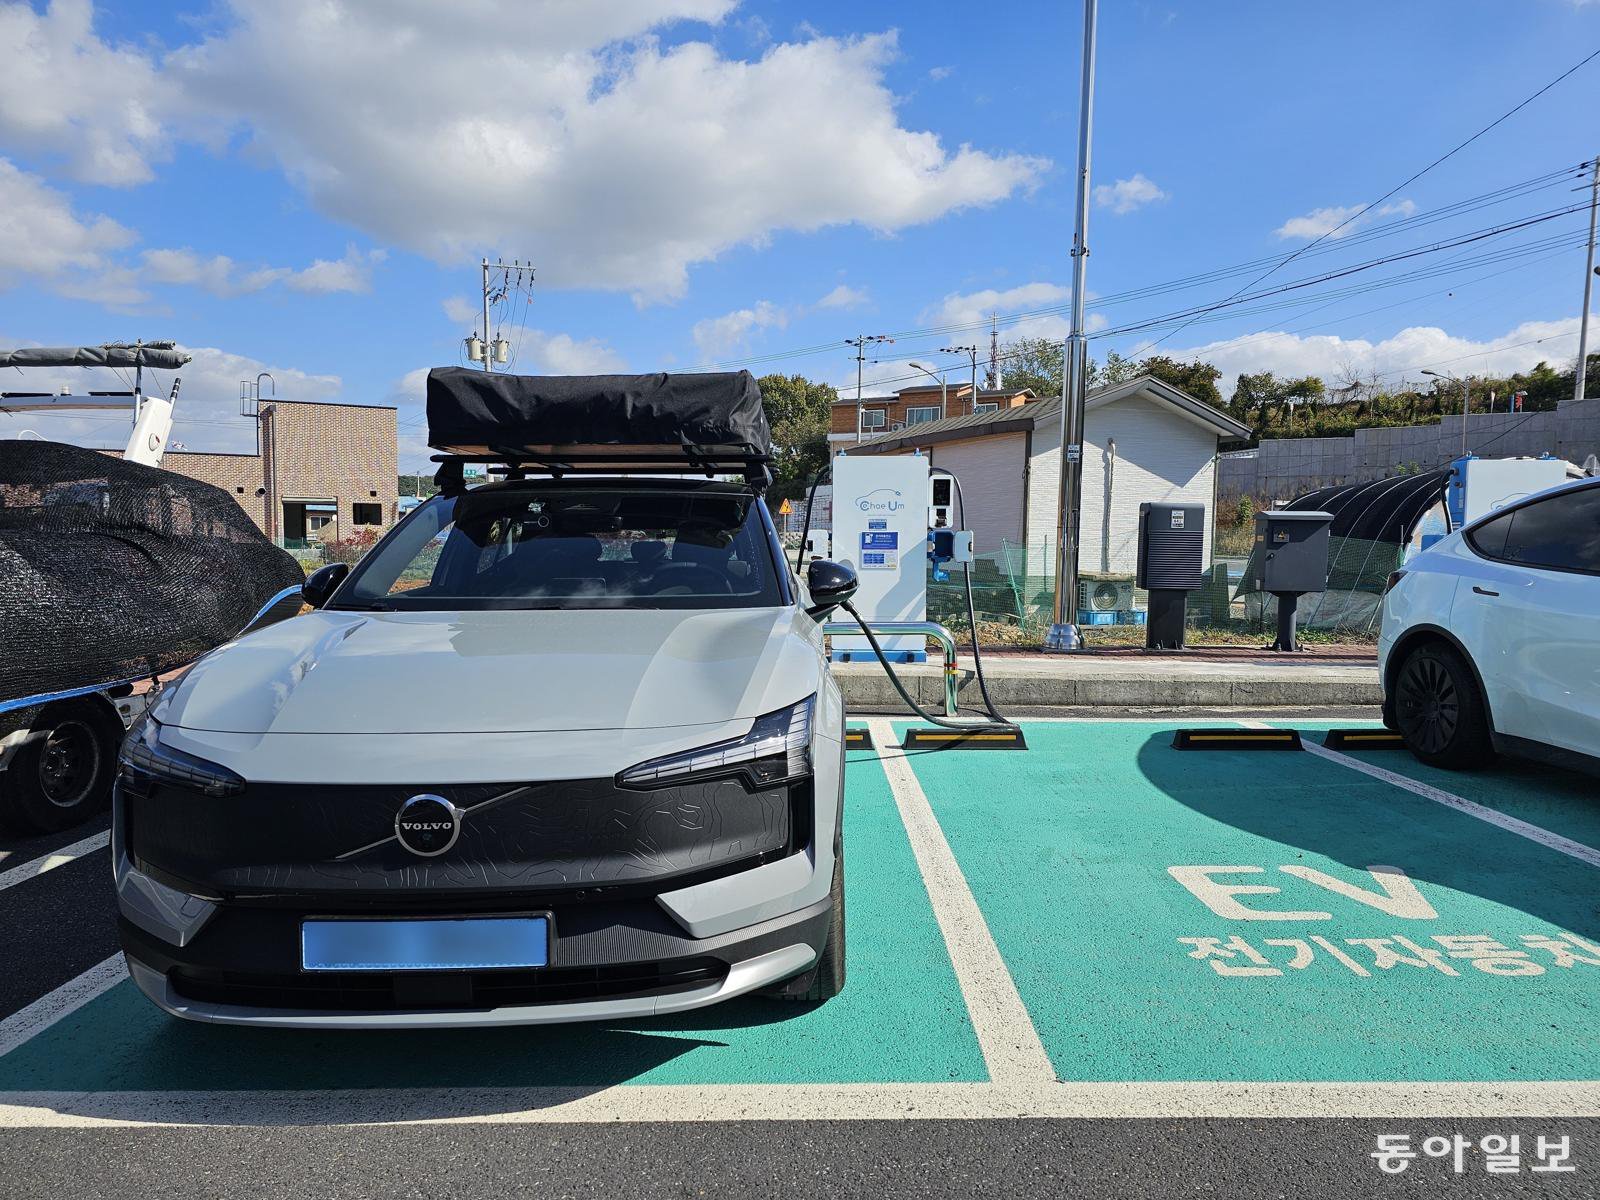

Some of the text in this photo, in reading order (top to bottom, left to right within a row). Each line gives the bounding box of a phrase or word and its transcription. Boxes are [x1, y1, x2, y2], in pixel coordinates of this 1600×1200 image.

[888, 500, 905, 511] Um
[401, 822, 452, 831] VOLVO
[1168, 865, 1439, 921] EV
